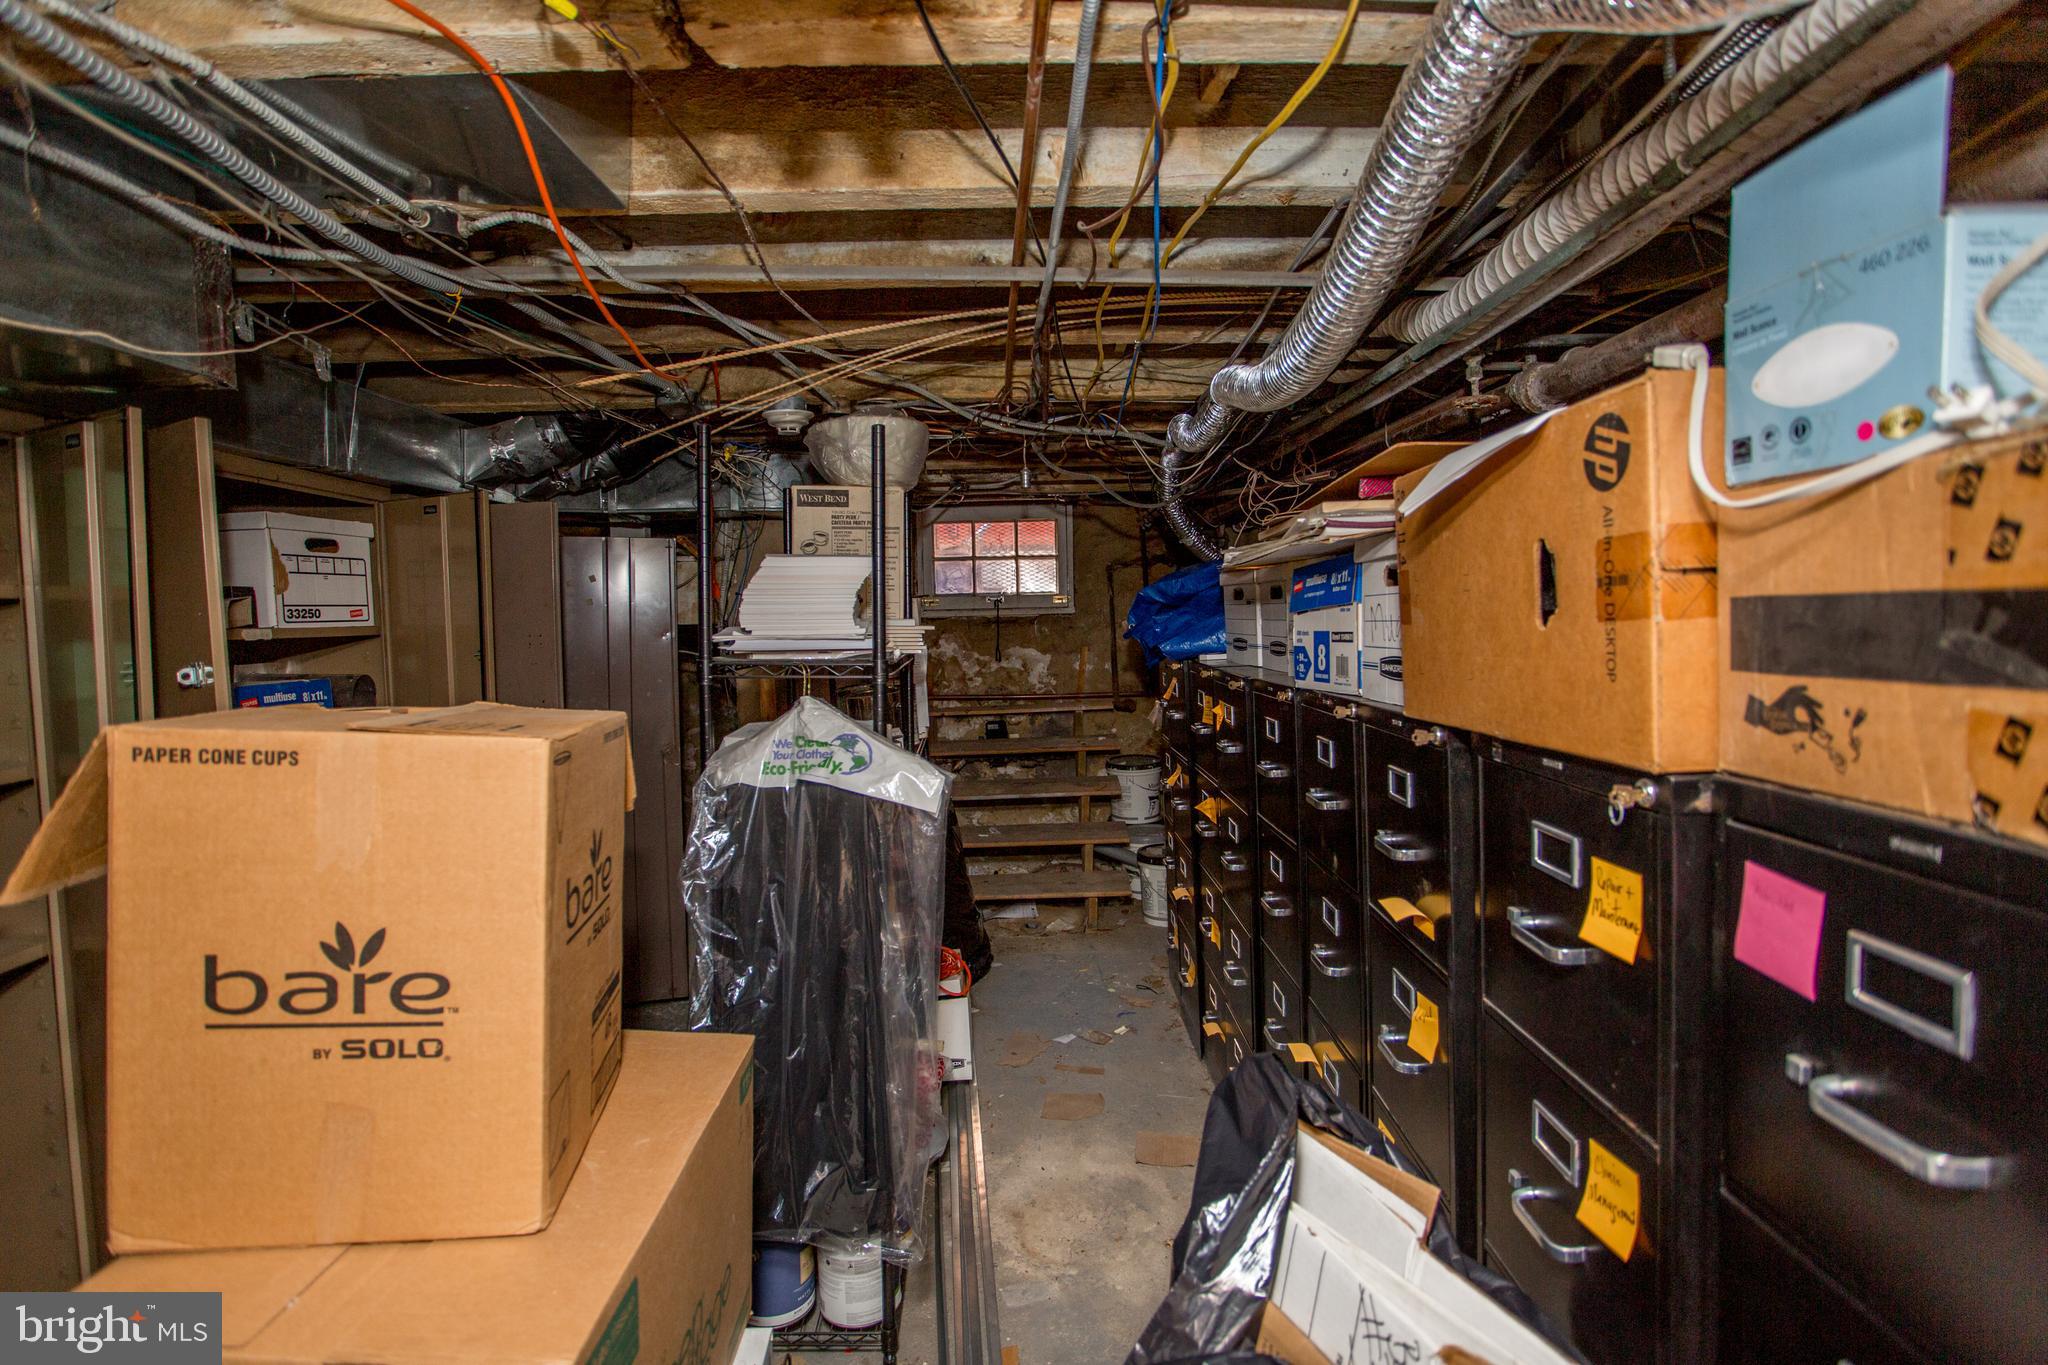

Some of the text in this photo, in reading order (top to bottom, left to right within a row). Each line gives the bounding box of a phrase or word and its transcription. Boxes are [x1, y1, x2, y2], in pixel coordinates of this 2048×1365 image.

[1583, 412, 1631, 492] hp
[799, 493, 847, 503] WEST BEND
[286, 608, 321, 619] 33250
[1603, 602, 1618, 683] DESKTOP
[1317, 643, 1326, 671] 8
[263, 692, 297, 704] multiuse
[773, 739, 792, 749] We
[131, 746, 300, 767] PAPER CONE CUPS
[773, 750, 794, 760] Your
[565, 855, 612, 929] bare
[204, 954, 451, 1016] bare
[312, 1038, 443, 1060] BY SOLO
